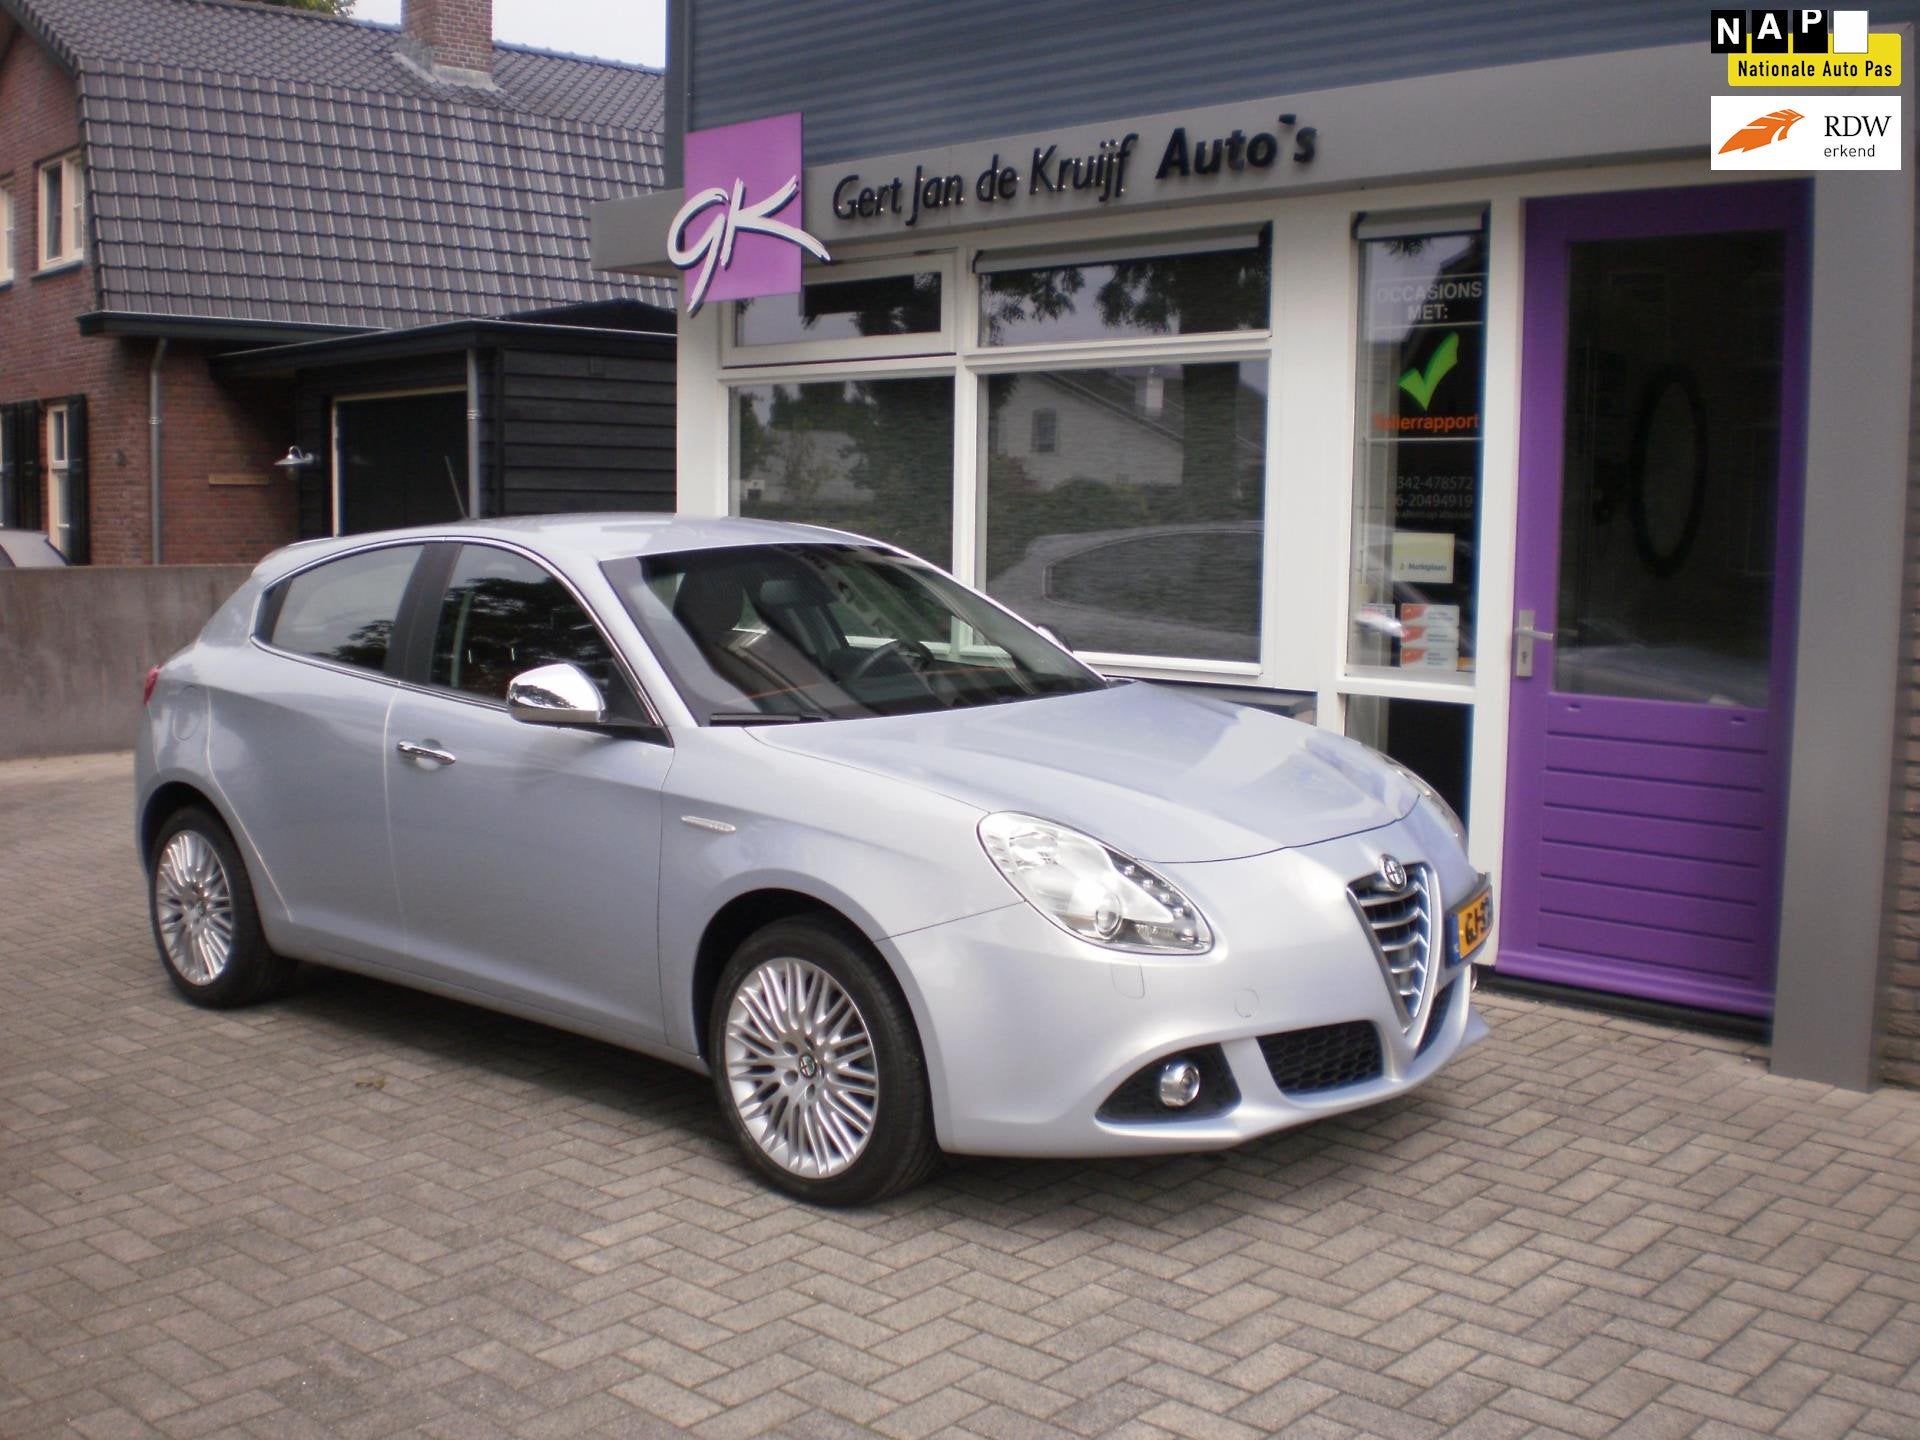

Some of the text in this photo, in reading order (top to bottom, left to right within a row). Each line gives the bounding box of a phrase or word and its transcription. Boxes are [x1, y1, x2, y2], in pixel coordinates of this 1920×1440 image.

[832, 113, 1318, 226] Gert Jan de Kruijf Auto's
[1376, 280, 1483, 302] OCCASIONS
[1407, 303, 1449, 322] MET:
[1395, 474, 1474, 490] 342-478572
